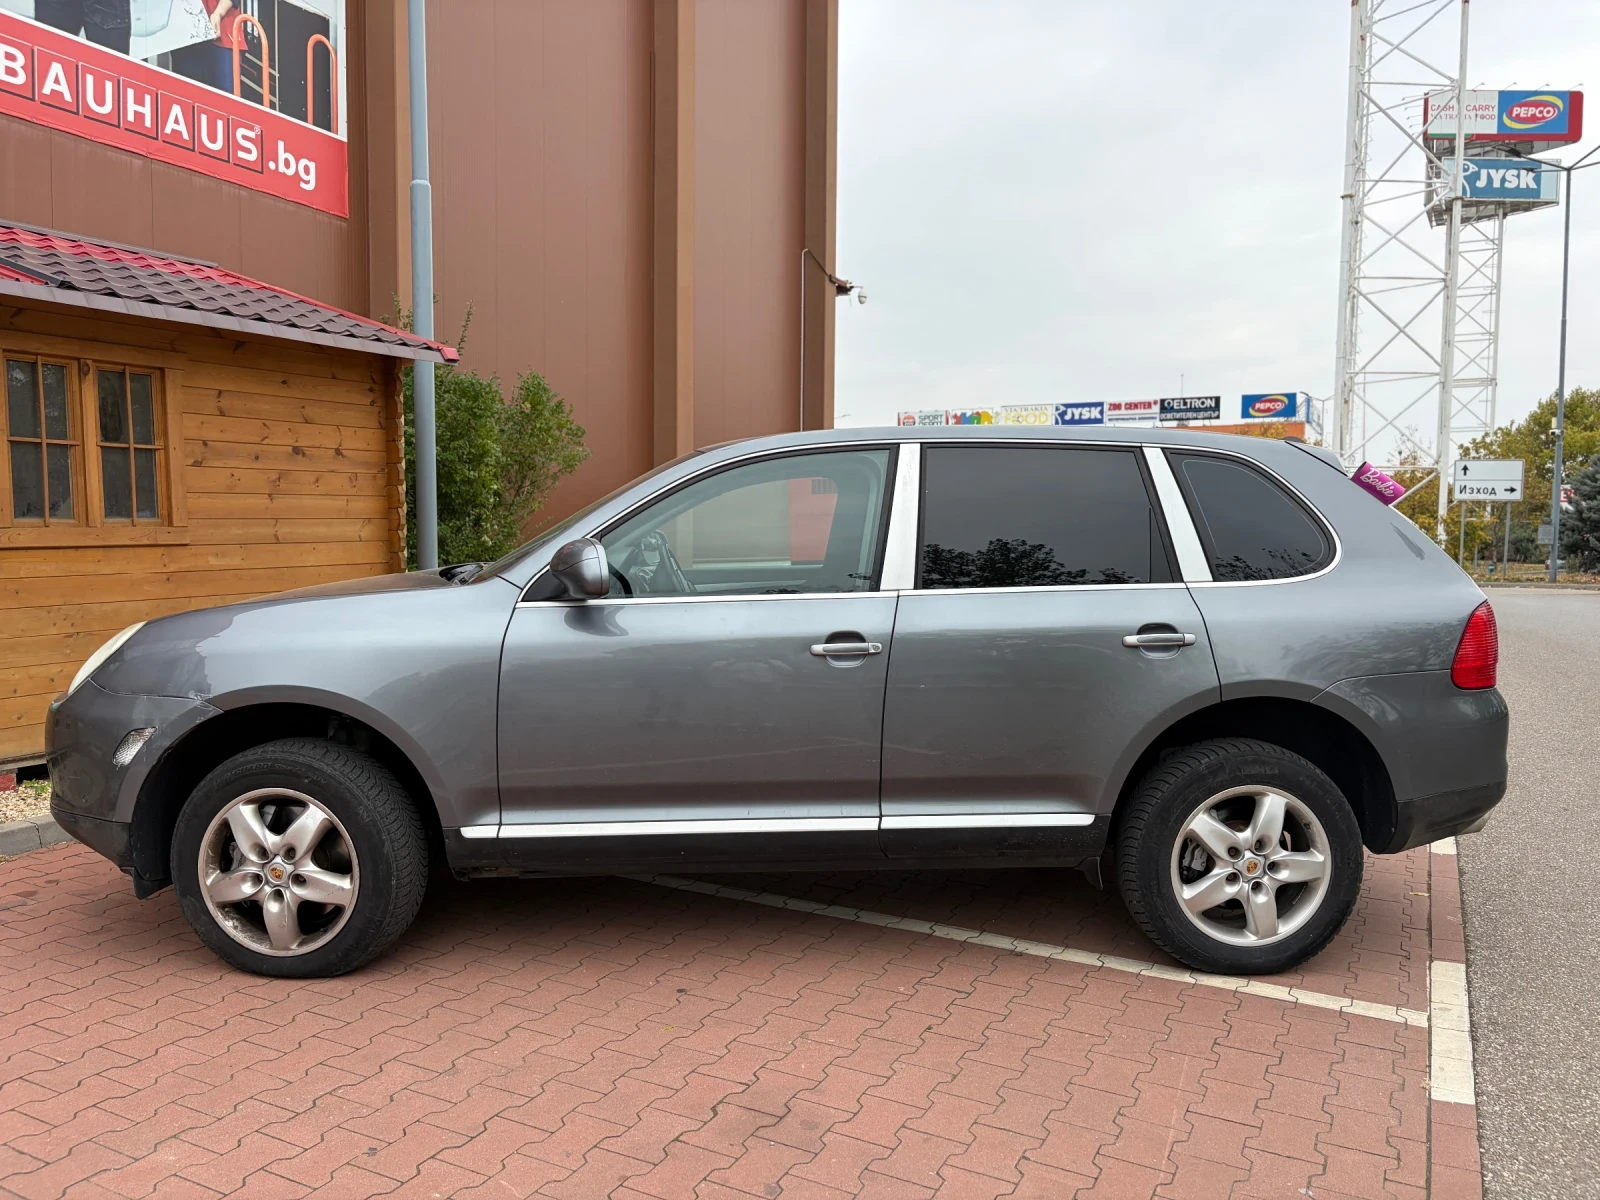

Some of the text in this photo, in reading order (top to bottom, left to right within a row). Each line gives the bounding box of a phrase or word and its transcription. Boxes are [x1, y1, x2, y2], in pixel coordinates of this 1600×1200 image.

[1430, 104, 1496, 112] CASH CARRY
[1512, 106, 1555, 118] PEPCO
[1475, 168, 1538, 189] JYSK
[1019, 405, 1048, 413] TRAKIA
[1108, 401, 1152, 411] ZOO CENTER
[1254, 401, 1282, 411] PEPCO
[918, 414, 944, 422] SPORT
[1004, 411, 1049, 425] FOOD
[1064, 406, 1102, 420] JYSK
[1360, 467, 1395, 497] Barbie
[1459, 484, 1497, 496] Изход
